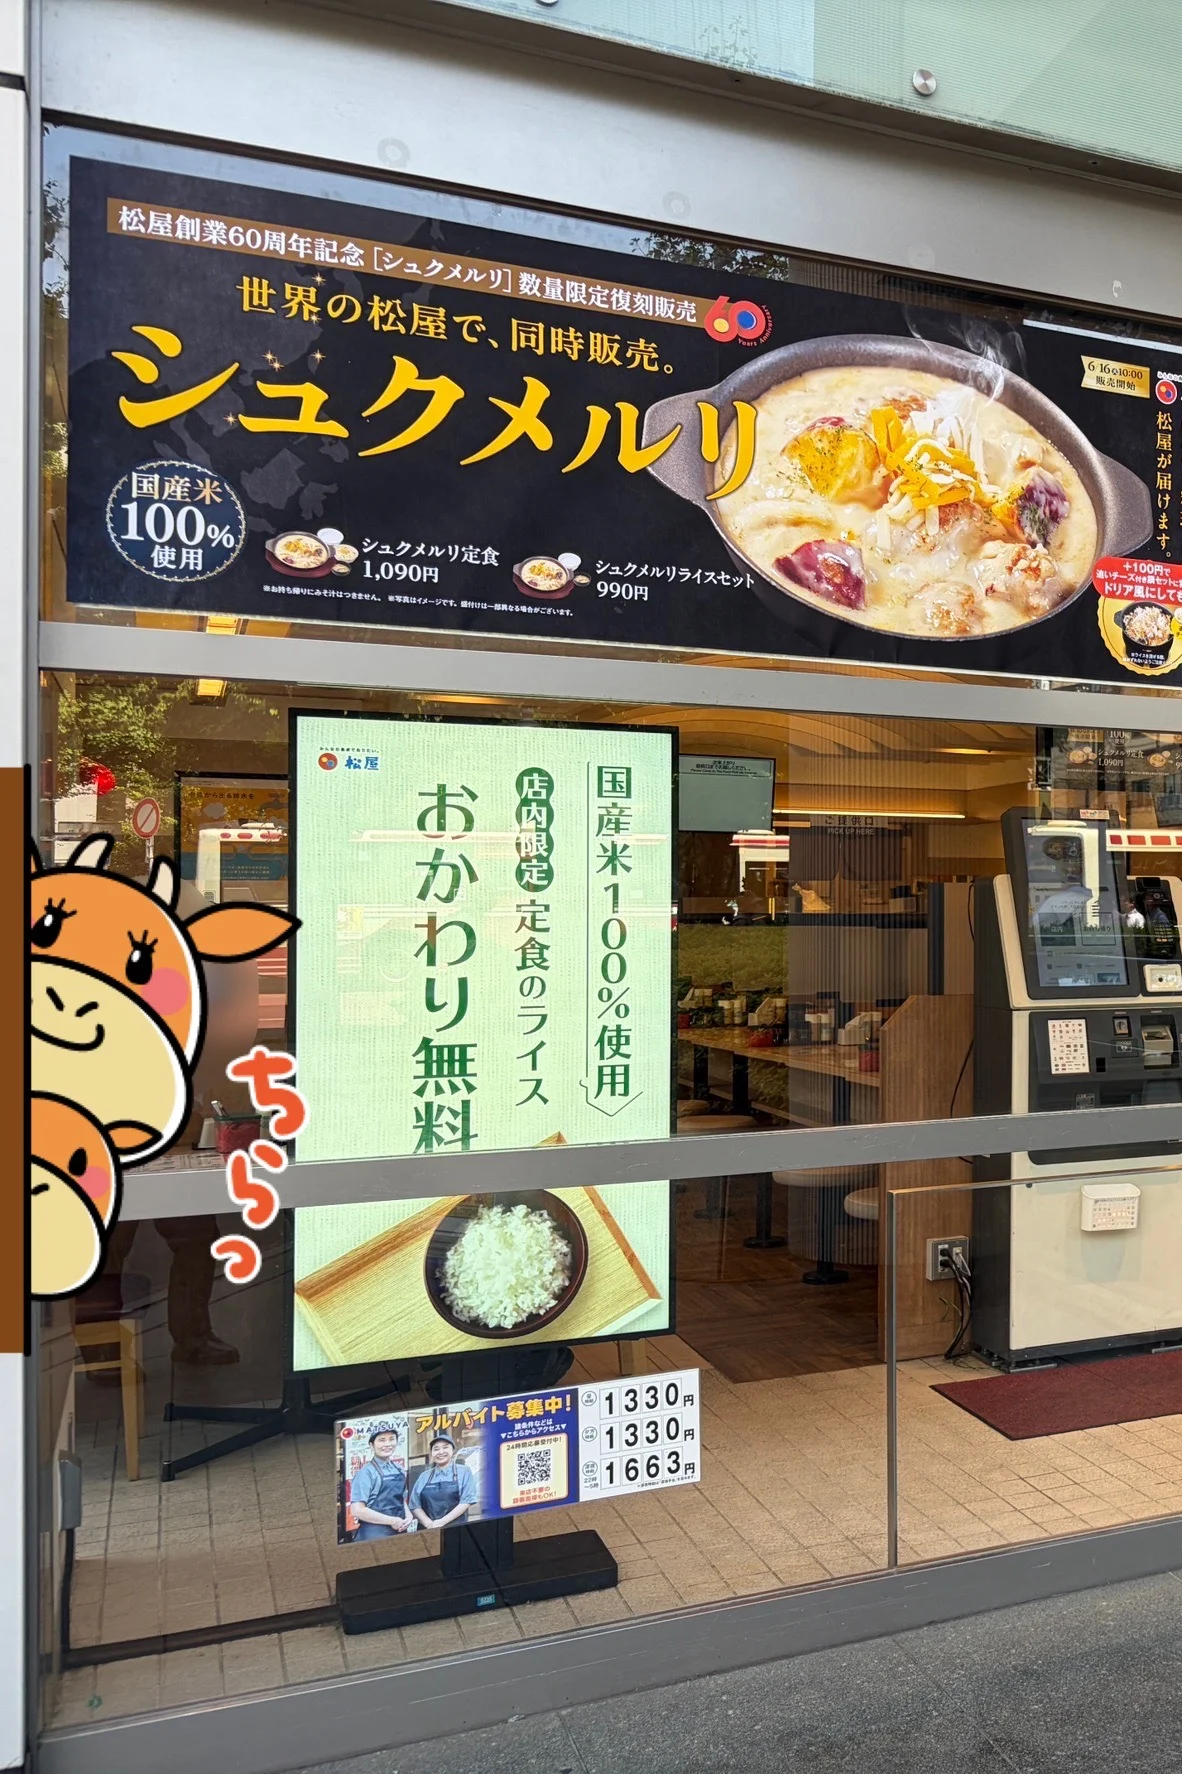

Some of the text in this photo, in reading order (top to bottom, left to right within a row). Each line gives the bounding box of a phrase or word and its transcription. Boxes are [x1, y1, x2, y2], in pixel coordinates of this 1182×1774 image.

[236, 276, 674, 374] 世界の松屋で、同時販売。
[704, 296, 766, 343] 60
[1096, 376, 1136, 390] 販売開始
[111, 325, 757, 501] シュクメルリ
[131, 472, 223, 505] 国産米
[1156, 411, 1172, 557] 松屋が届けます。
[120, 501, 235, 549] 100%
[151, 545, 204, 570] 使用
[362, 538, 500, 566] シュクメルリ定食
[363, 560, 439, 583] 1,090円
[595, 560, 755, 589] シュクメルリライスセット
[597, 581, 648, 601] 990円
[345, 756, 379, 770] 松屋
[514, 772, 551, 1107] 店内限定 定食のライス
[595, 766, 632, 1099] 国産米100%使用
[412, 784, 478, 1153] おかわり無料
[356, 1421, 409, 1435] MATSUYA
[416, 1394, 572, 1434] アルバイト募集中!
